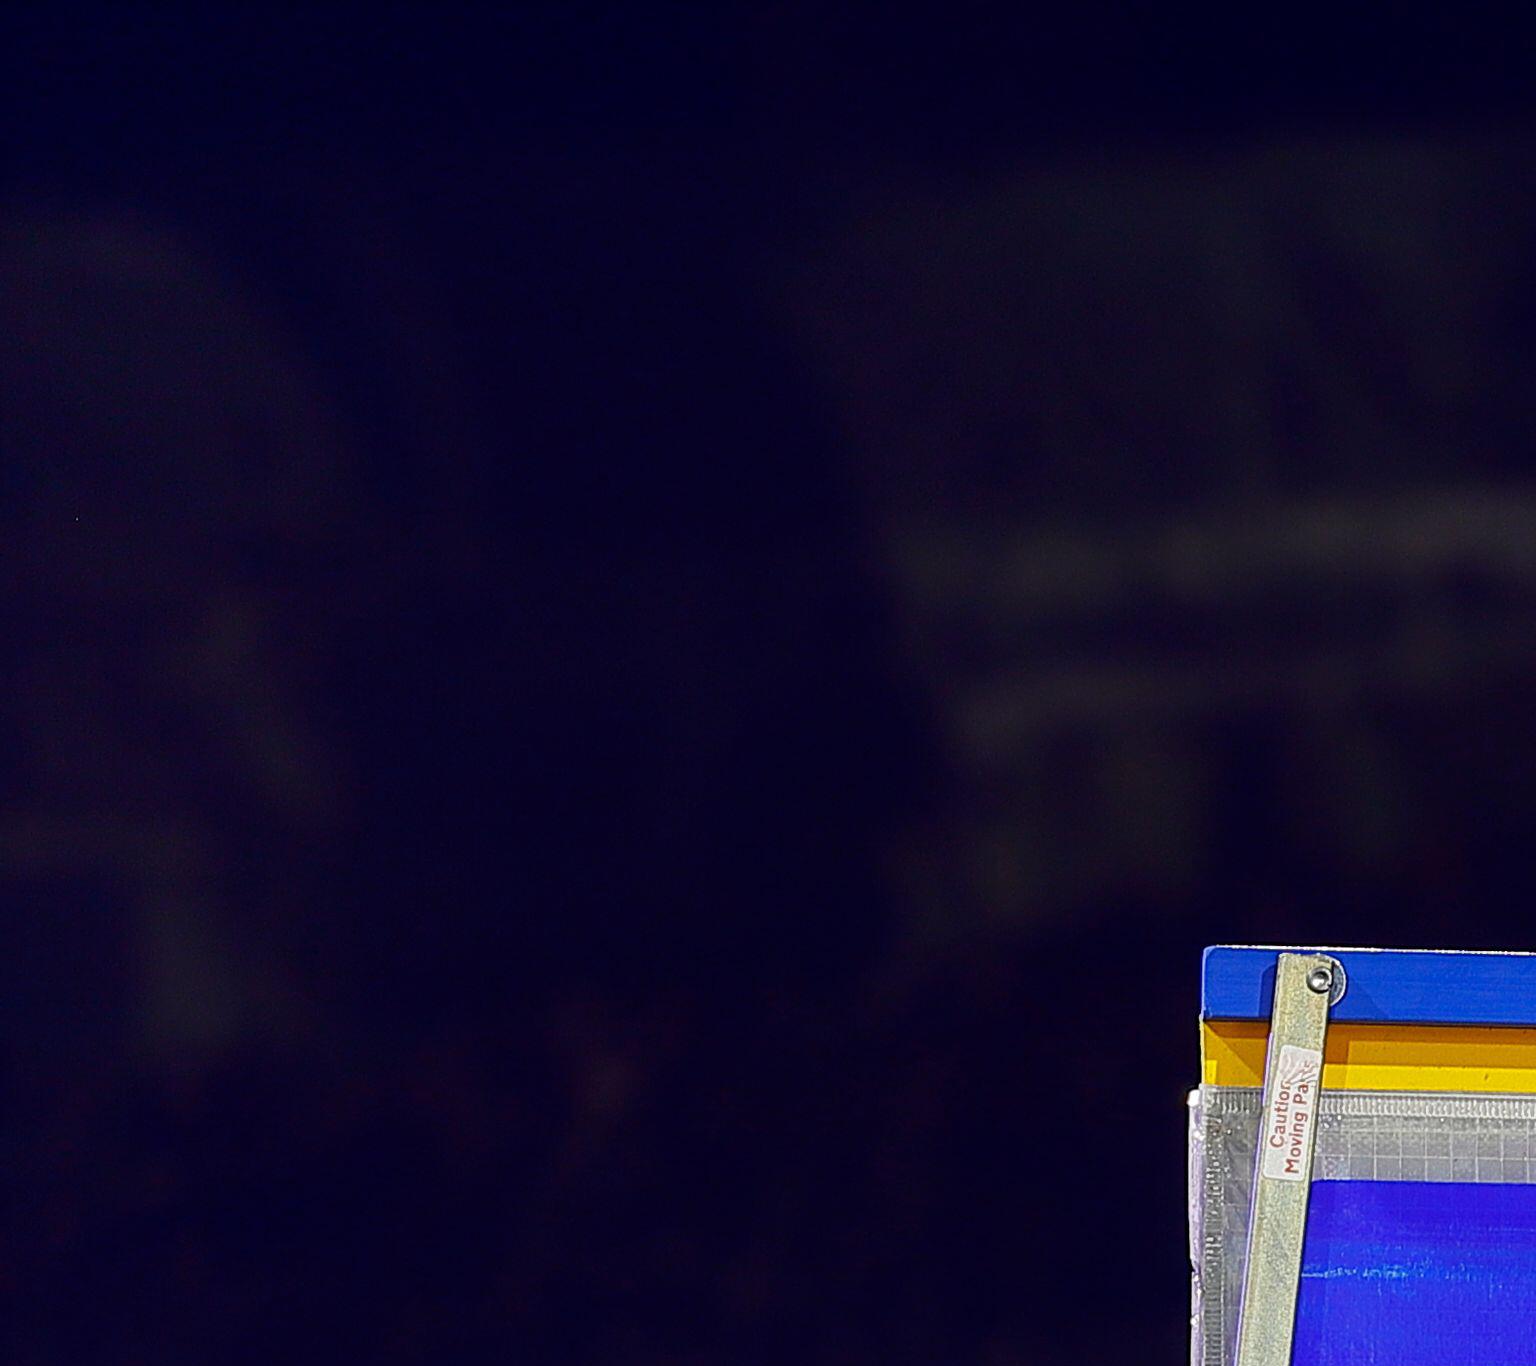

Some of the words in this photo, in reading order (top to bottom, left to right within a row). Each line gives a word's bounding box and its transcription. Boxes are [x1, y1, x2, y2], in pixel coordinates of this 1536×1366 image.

[1293, 1060, 1311, 1105] Pas
[1270, 1081, 1291, 1148] Caution
[1285, 1112, 1308, 1173] Moving
